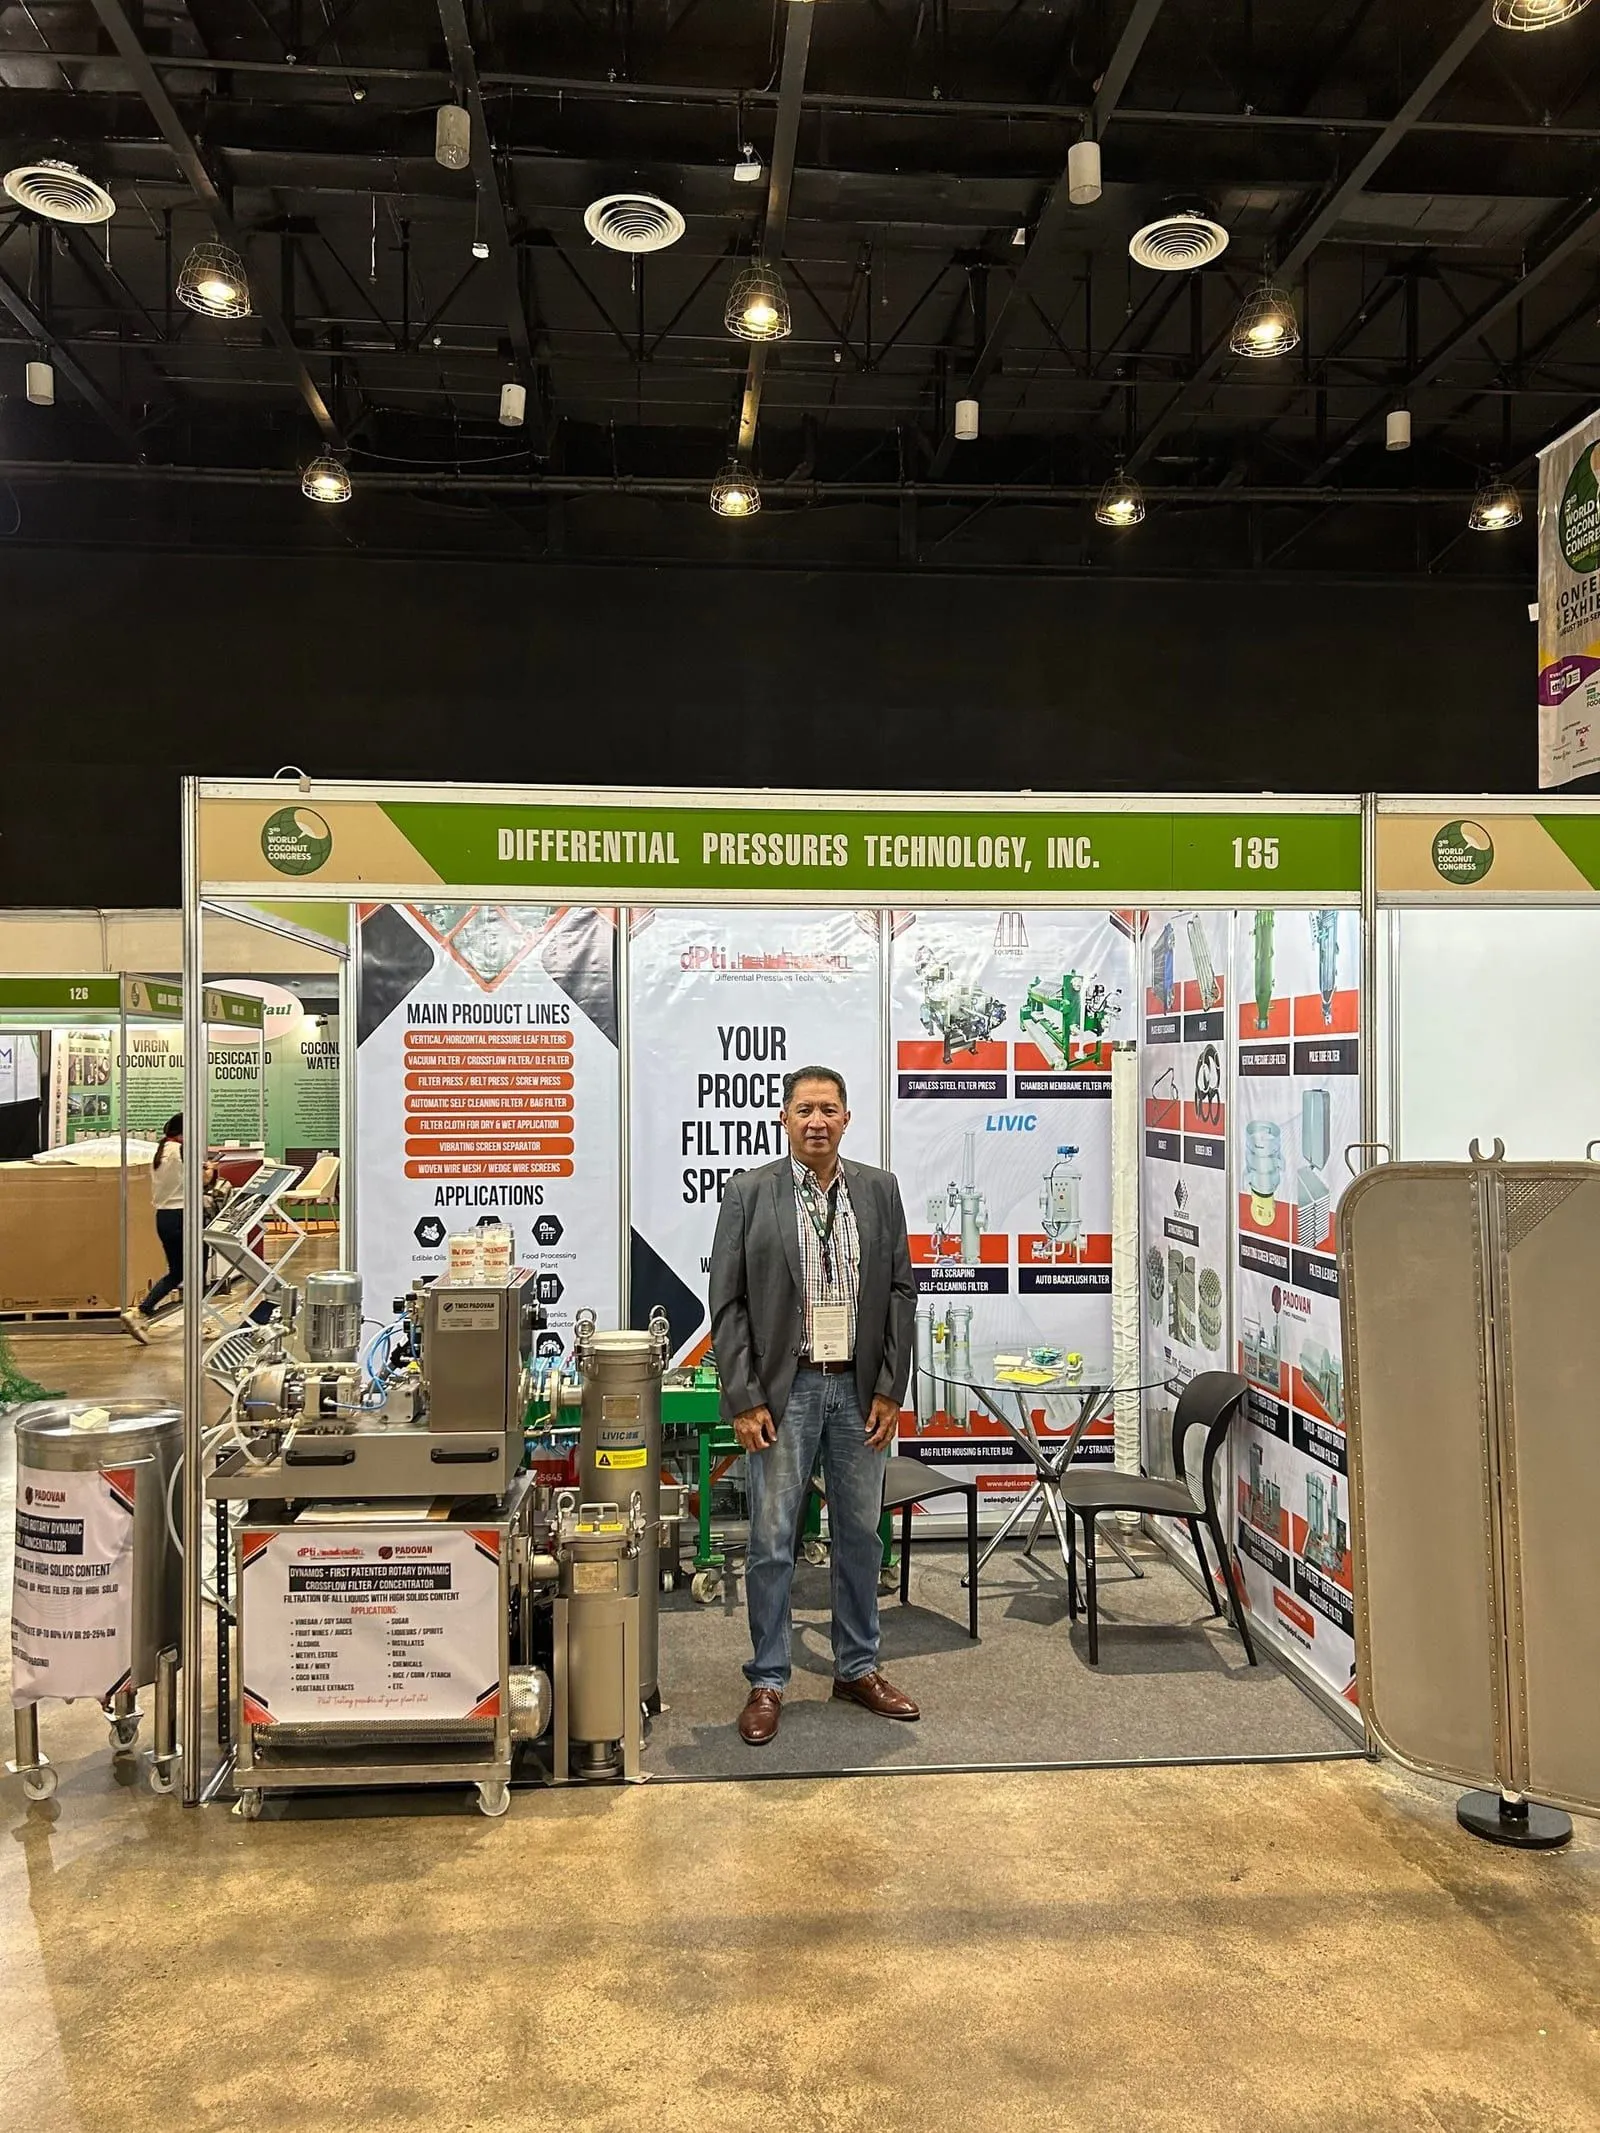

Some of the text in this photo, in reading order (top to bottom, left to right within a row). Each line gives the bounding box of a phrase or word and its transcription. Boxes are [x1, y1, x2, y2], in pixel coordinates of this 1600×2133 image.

[1566, 500, 1595, 527] WORLD
[1566, 512, 1600, 541] COCONU
[497, 827, 1280, 873] DIFFERENTIAL PRESSURES TECHNOLOGY, INC. 135
[1438, 848, 1464, 856] WORLD
[1438, 863, 1476, 871] CONGRESS
[69, 988, 88, 1000] 126
[407, 1004, 570, 1024] MAIN PRODUCT LINES
[410, 1035, 567, 1044] VERTICAL/HORIZONTAL PRESSURE LEAF FILTERS
[718, 1026, 787, 1061] YOUR
[133, 1040, 169, 1052] VIRGIN
[408, 1056, 436, 1065] VACUUM
[438, 1056, 460, 1065] FILTER
[467, 1056, 506, 1065] CROSSFLOW
[548, 1055, 569, 1064] FILTER
[418, 1077, 561, 1086] FILTER PRESS BELT PRESS SCREW PRESS
[908, 1081, 997, 1090] STAINLESS STEEL FILTER PRESS
[1020, 1082, 1101, 1091] CHAMBER MEMBRANE FILTER
[411, 1098, 567, 1108] AUTOMATIC SELF CLEANING FILTER BAG FILTER
[420, 1120, 559, 1129] FILTER CLOTH FOR DRY WET APPLICATION
[986, 1115, 1037, 1131] LIVIC
[440, 1142, 541, 1151] VIBRATING SCREEN SEPARATOR
[418, 1163, 560, 1173] WOVEN WIRE MESH WEDGE WIRE SCREENS
[435, 1185, 544, 1206] APPLICATIONS
[540, 1252, 576, 1260] Processing
[931, 1269, 975, 1278] DFA SCRAPING
[1035, 1275, 1110, 1285] AUTO BACKFLUSH FILTER
[919, 1282, 989, 1291] SELF-CLEANING FILTER
[1283, 1290, 1311, 1314] PADOVAN
[920, 1447, 1013, 1456] BAG FILTER HOUSING FILTER BAG
[35, 1489, 66, 1502] PADOVAN
[51, 1522, 83, 1535] DYNAMIC
[395, 1546, 433, 1554] PADOVAN
[50, 1564, 74, 1576] SOLIDS
[75, 1563, 111, 1576] CONTENT
[290, 1566, 449, 1577] DYNAMOS FIRST PATENTED ROTARY DYNAMIC
[306, 1580, 434, 1590] CROSSFLOW FILTER CONCENTRATOR
[284, 1592, 459, 1604] FILTRATION OF ALL LIQUIDS WITH HIGH SOLIDS CONTENT
